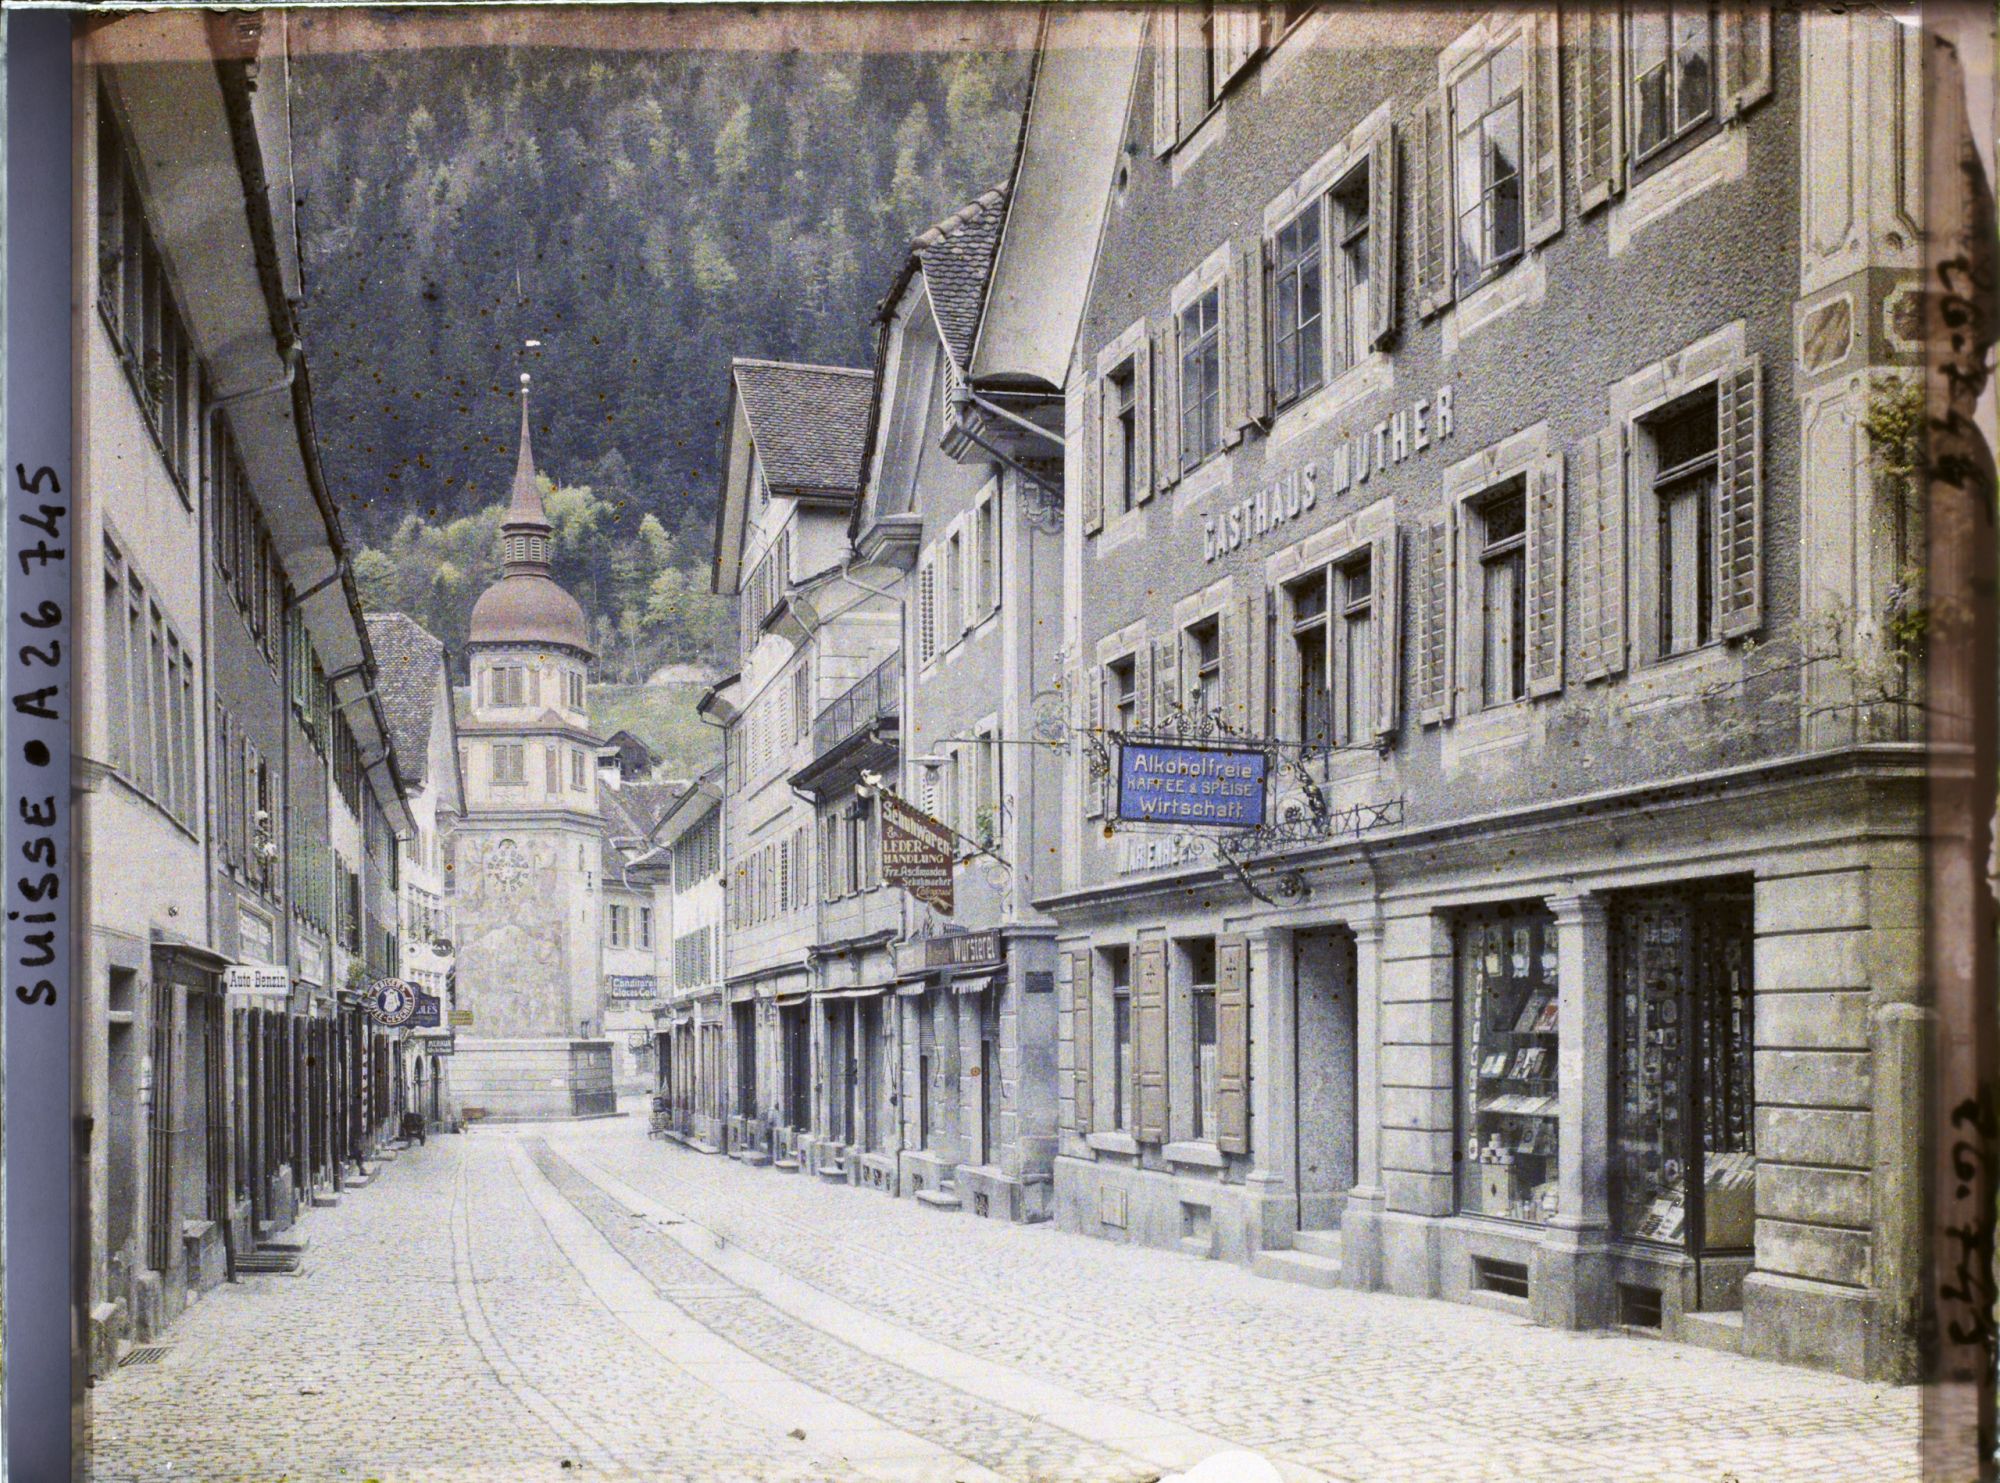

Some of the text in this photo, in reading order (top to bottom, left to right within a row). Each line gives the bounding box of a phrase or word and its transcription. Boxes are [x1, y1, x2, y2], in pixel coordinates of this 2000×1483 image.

[1203, 385, 1454, 564] GASTHAUS MUTHER
[16, 464, 66, 575] 745
[1133, 753, 1253, 778] Alkoholfreie
[1127, 777, 1253, 797] KAFFEE & SPEISE
[883, 853, 944, 864] HANDLUNG
[229, 969, 287, 989] Auto-Benzin
